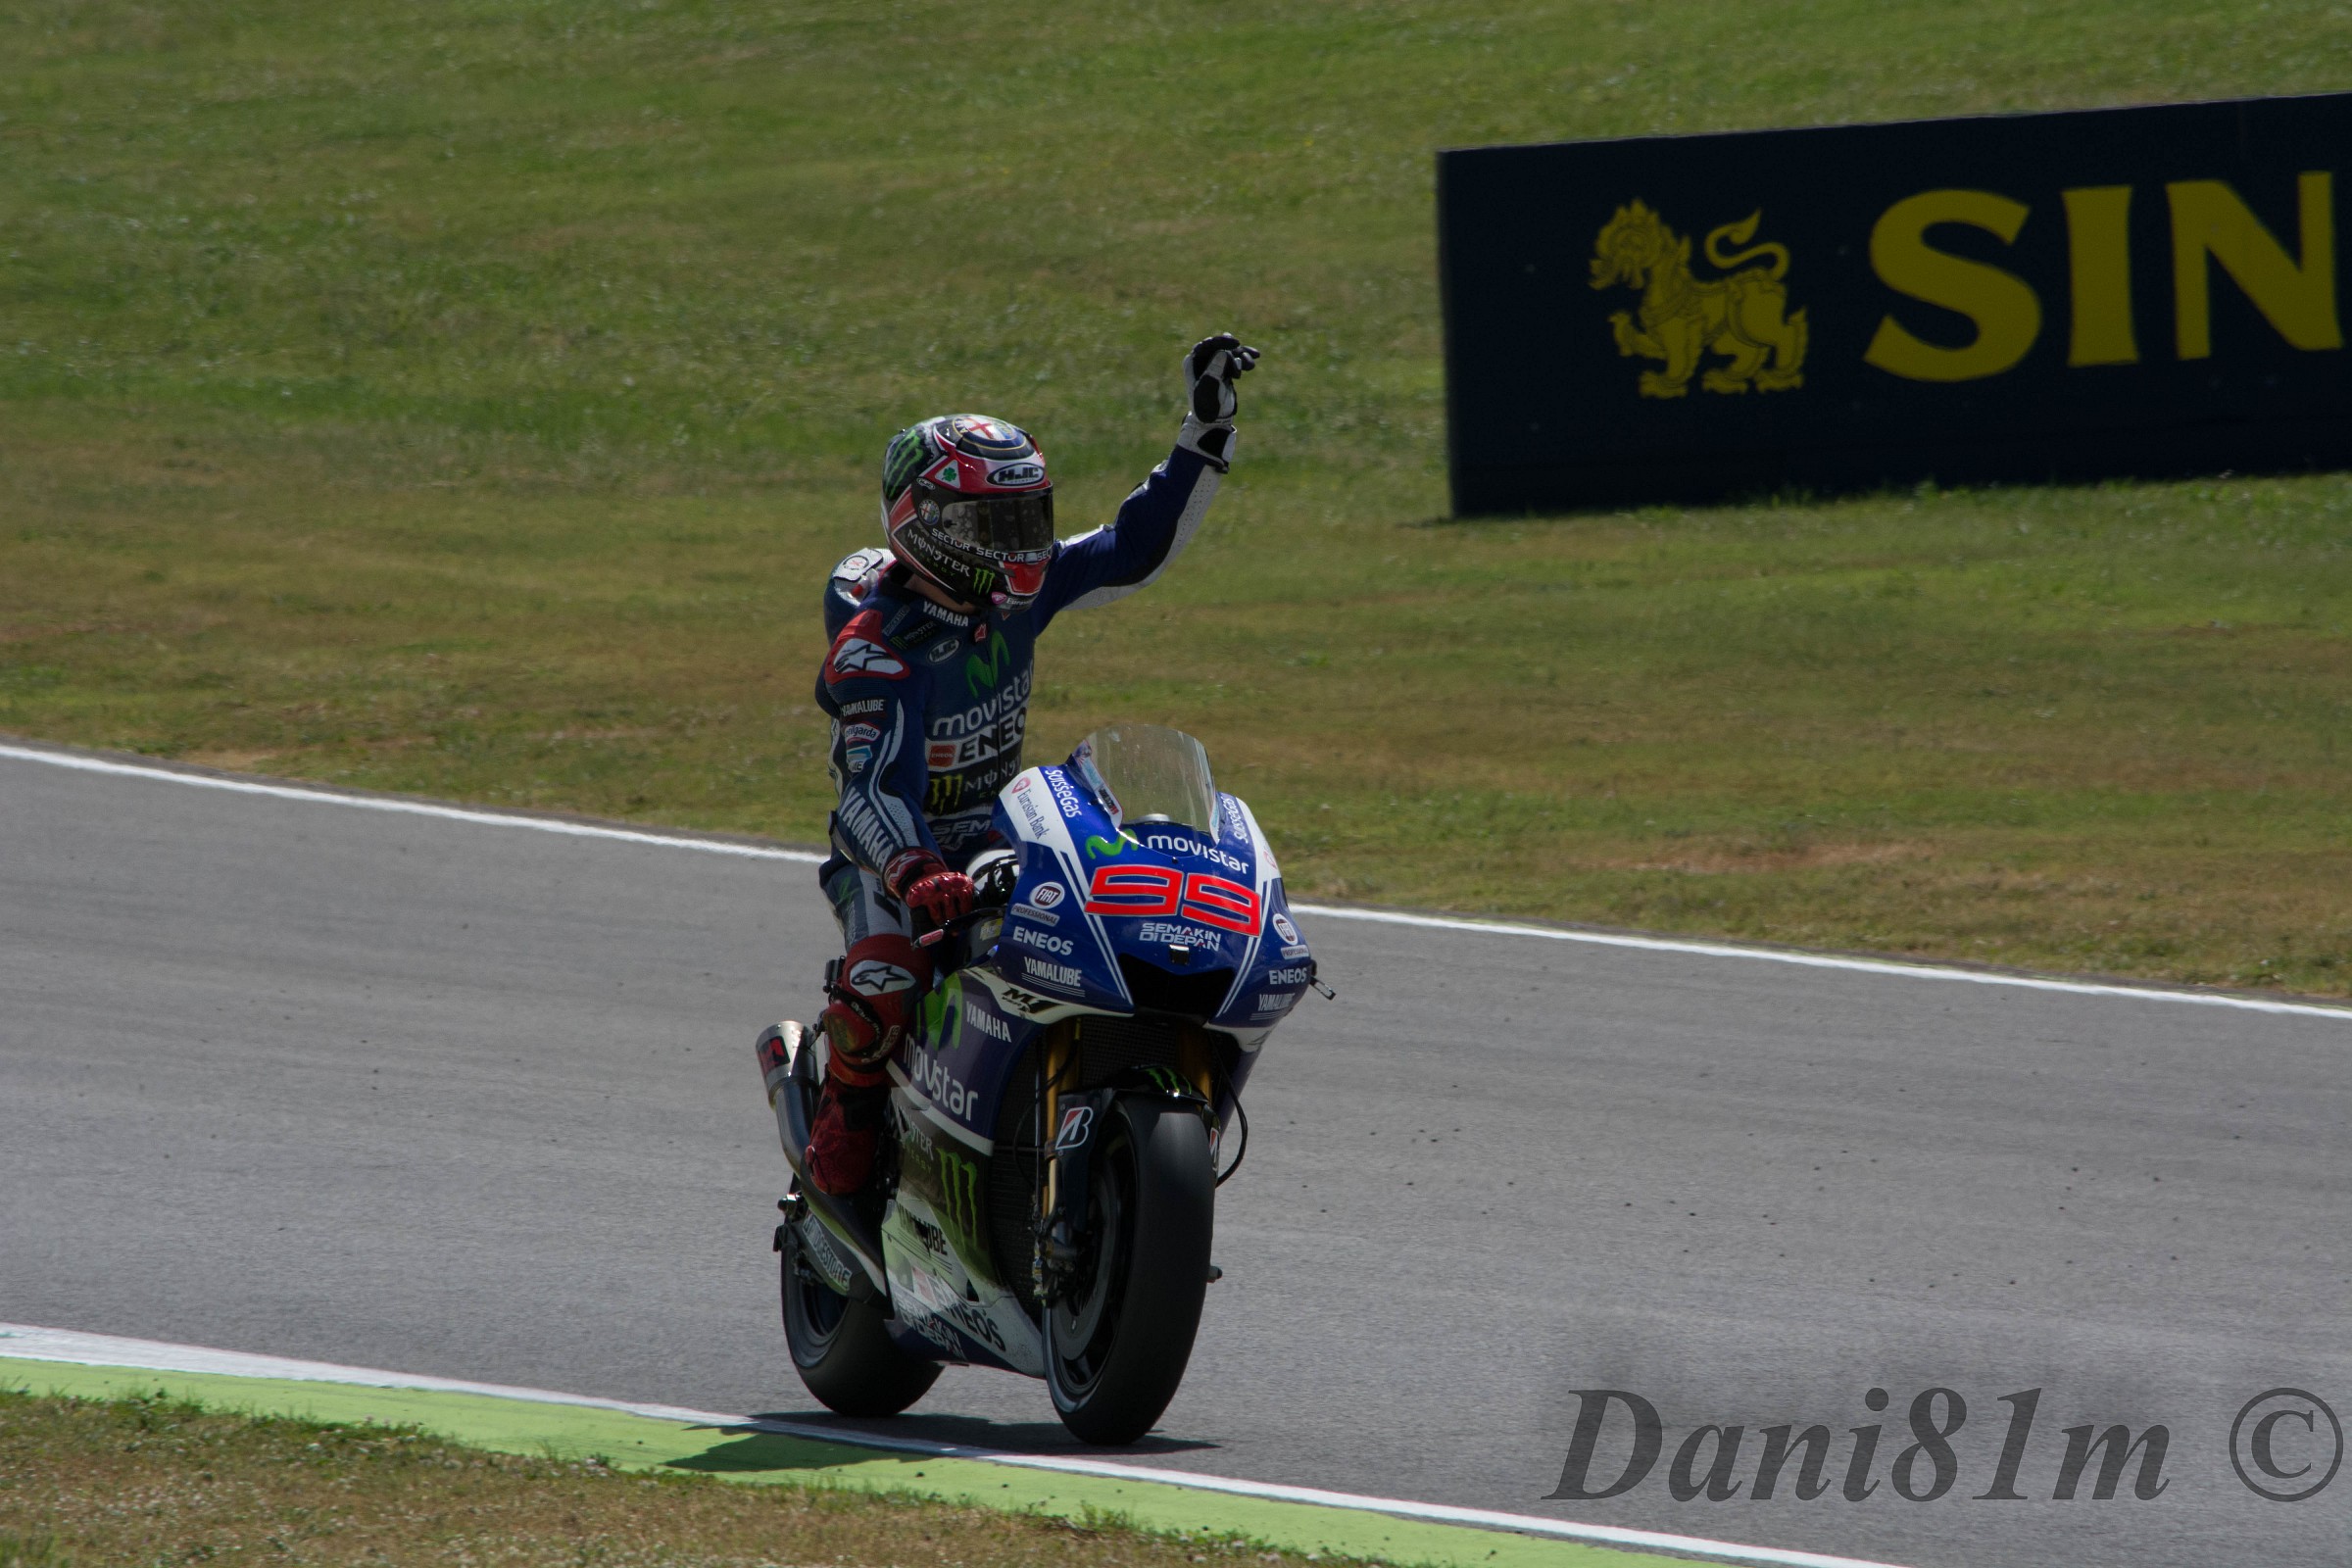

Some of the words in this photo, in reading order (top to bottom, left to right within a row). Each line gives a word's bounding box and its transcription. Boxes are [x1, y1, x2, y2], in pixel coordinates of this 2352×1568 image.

[1863, 170, 2345, 382] SIN
[998, 466, 1039, 482] HJC
[907, 528, 971, 577] MONSTER
[931, 527, 971, 552] SECTOR
[975, 547, 1025, 563] SECTOR
[922, 600, 969, 627] YAMAHA
[840, 699, 885, 716] YAMALUBE
[1017, 789, 1039, 821] Eurasian
[1029, 815, 1051, 840] Bank
[1147, 834, 1249, 874] movistar
[1038, 887, 1059, 902] FIAT
[1084, 864, 1262, 938] 99
[1012, 905, 1058, 925] PROFESSIONAL
[1012, 925, 1075, 956] ENEOS
[1139, 931, 1160, 943] DI
[1160, 933, 1221, 953] DEPAN
[1141, 922, 1222, 944] SEMAKIN
[1023, 956, 1083, 988] YAMALUBE
[1268, 967, 1308, 986] ENEOS
[964, 1001, 1013, 1043] YAMAHA
[902, 1032, 979, 1122] movistar
